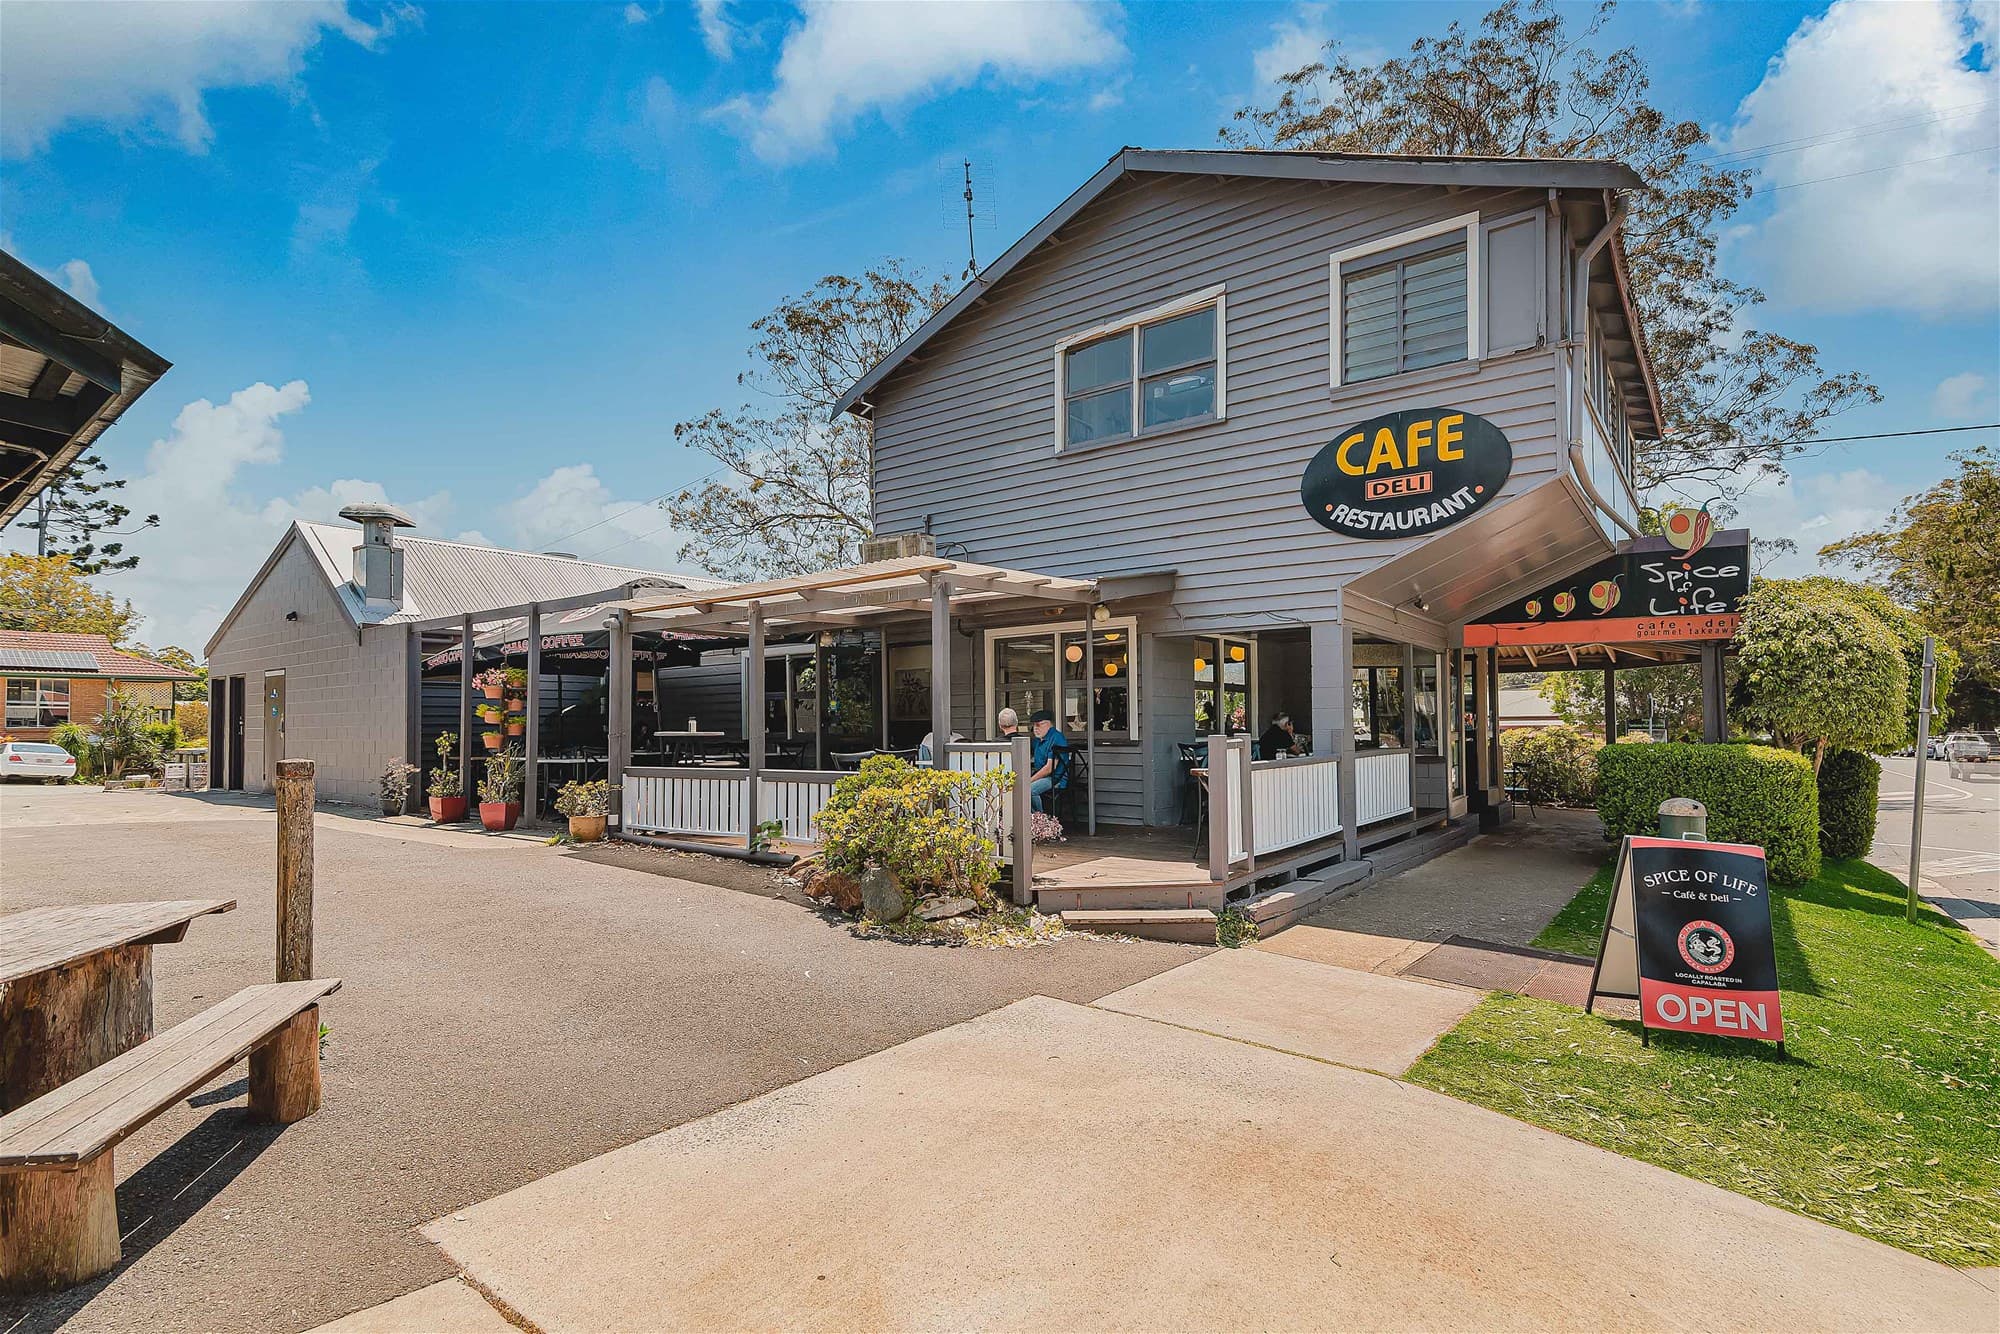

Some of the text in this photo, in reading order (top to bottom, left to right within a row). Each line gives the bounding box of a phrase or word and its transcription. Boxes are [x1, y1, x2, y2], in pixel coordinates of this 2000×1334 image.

[1335, 414, 1464, 476] CAFE
[1372, 480, 1425, 497] DELI
[1329, 485, 1477, 531] RESTAURANT
[1640, 562, 1740, 591] Spice
[1677, 581, 1692, 593] of
[1649, 587, 1727, 615] Life
[1637, 617, 1734, 629] cafe del
[1637, 628, 1681, 637] gourmet
[542, 633, 585, 650] COFFEE
[1643, 869, 1758, 897] SPICE OF LIFE
[1673, 890, 1729, 903] Café & Deli
[1675, 972, 1704, 980] LOCALLY
[1704, 975, 1735, 983] ROASTED
[1656, 993, 1768, 1032] OPEN
